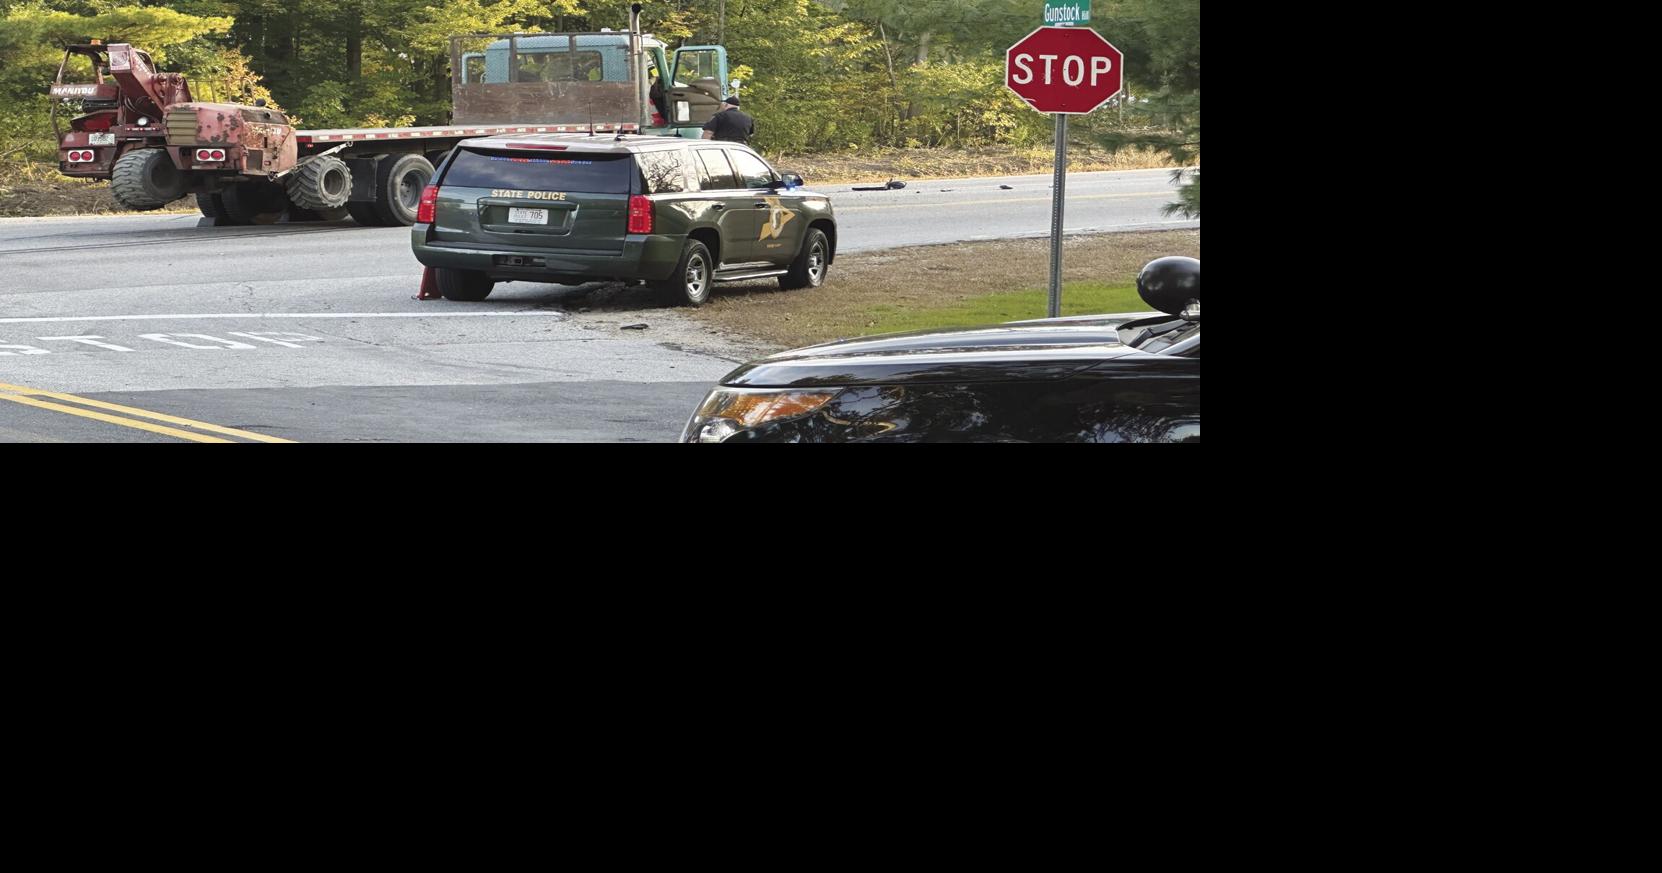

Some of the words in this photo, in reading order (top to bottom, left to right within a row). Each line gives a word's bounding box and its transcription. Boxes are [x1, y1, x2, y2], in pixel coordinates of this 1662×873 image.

[1044, 3, 1080, 22] Gunstock
[1012, 53, 1112, 87] STOP
[51, 87, 95, 95] MANITOU
[491, 189, 523, 198] STATE
[527, 191, 567, 200] POLICE
[529, 211, 543, 219] 705
